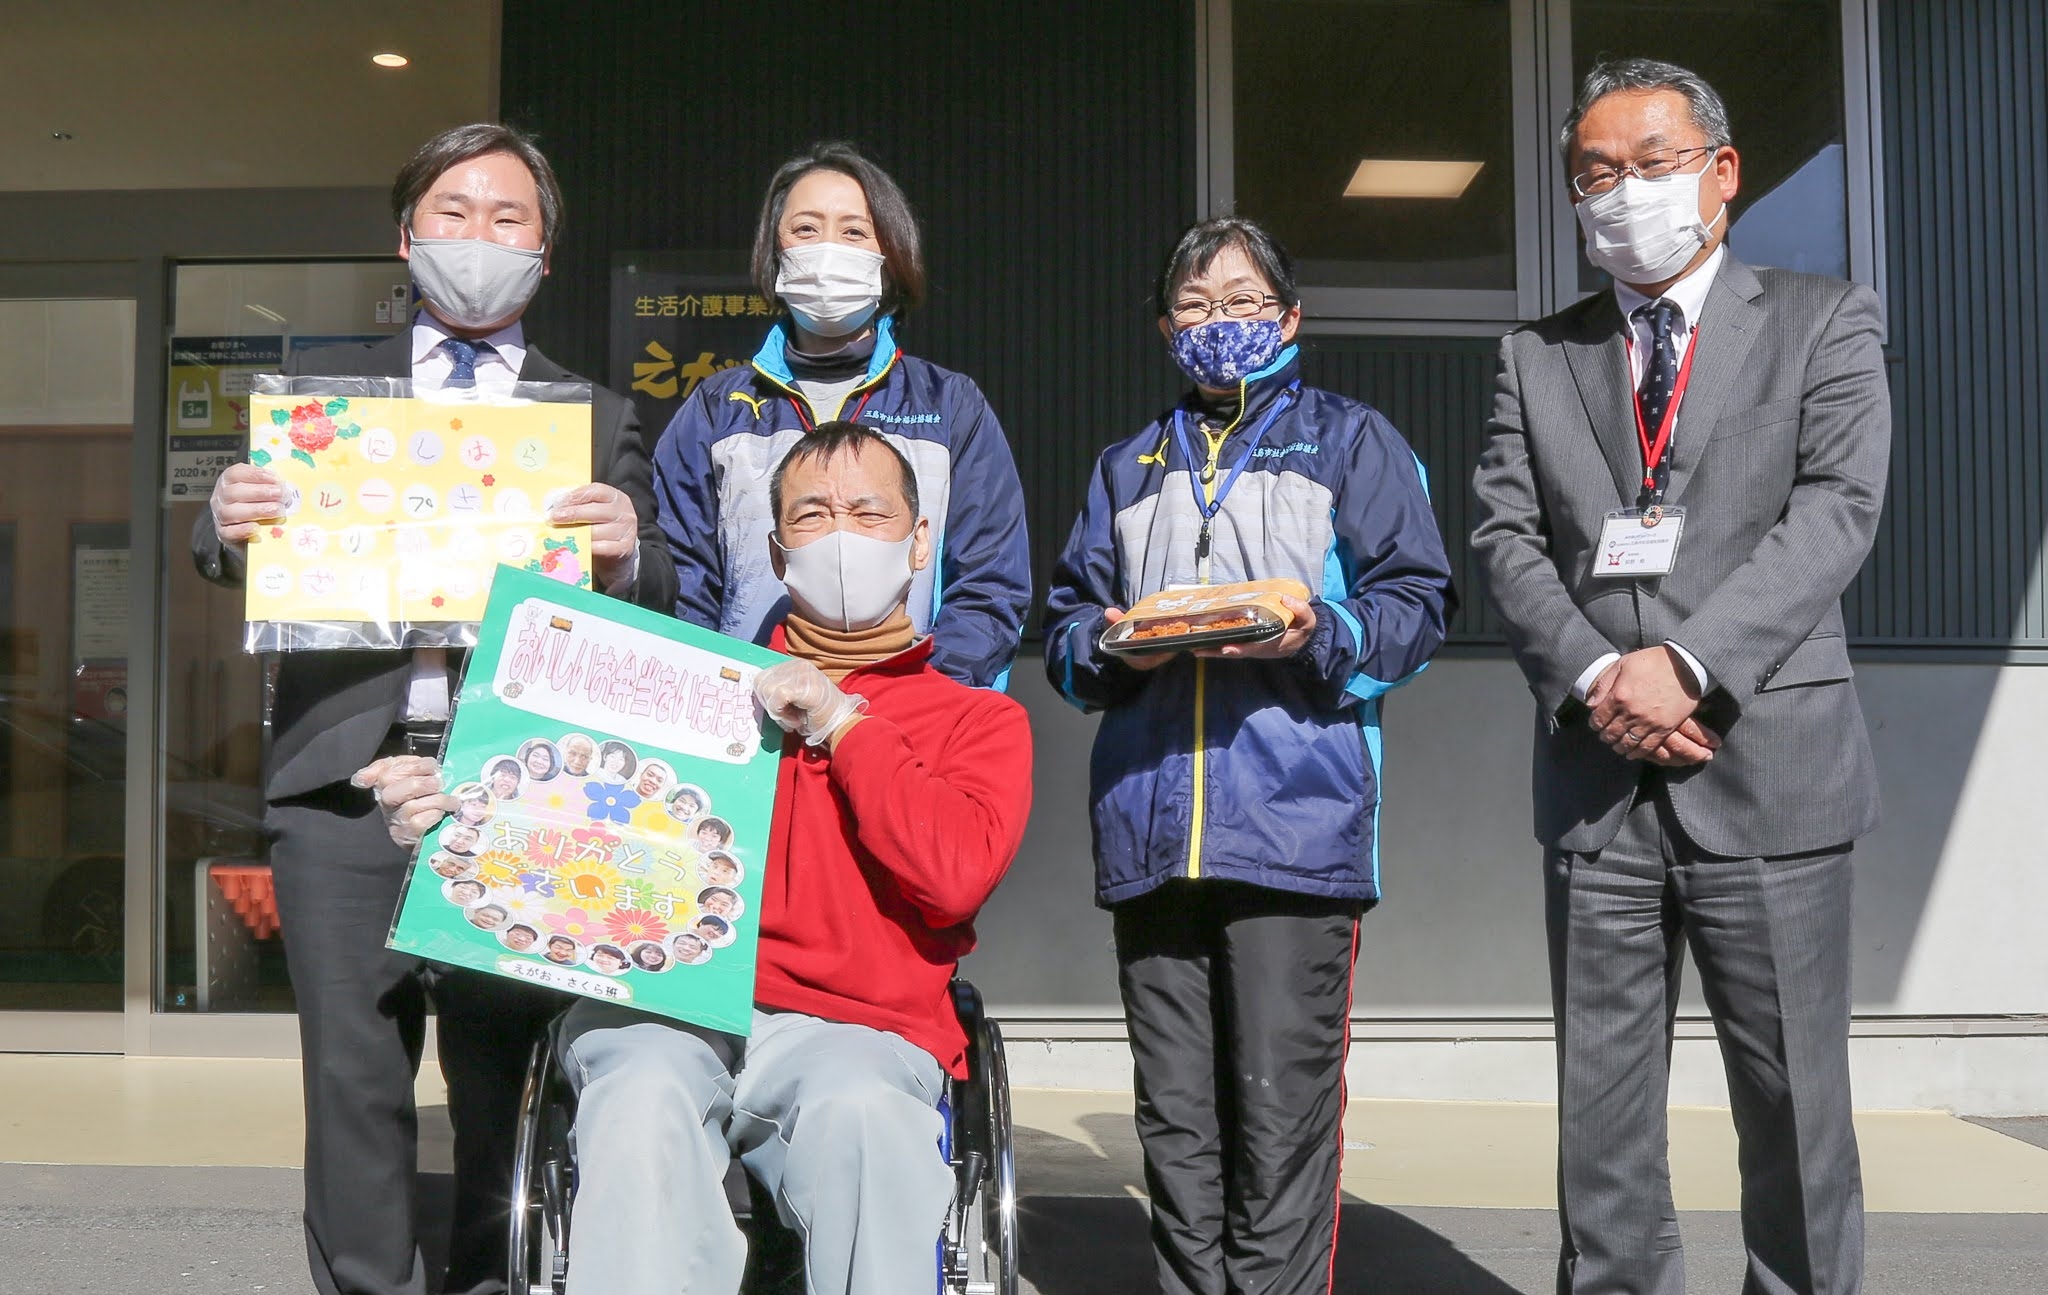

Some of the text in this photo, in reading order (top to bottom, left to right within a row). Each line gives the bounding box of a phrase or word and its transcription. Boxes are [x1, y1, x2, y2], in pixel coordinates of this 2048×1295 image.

[634, 295, 785, 317] 生活介護事業
[367, 437, 538, 467] にしはら
[491, 821, 687, 881] ありがとう
[489, 859, 686, 920] ございます
[513, 963, 619, 998] えがお・さくら班
